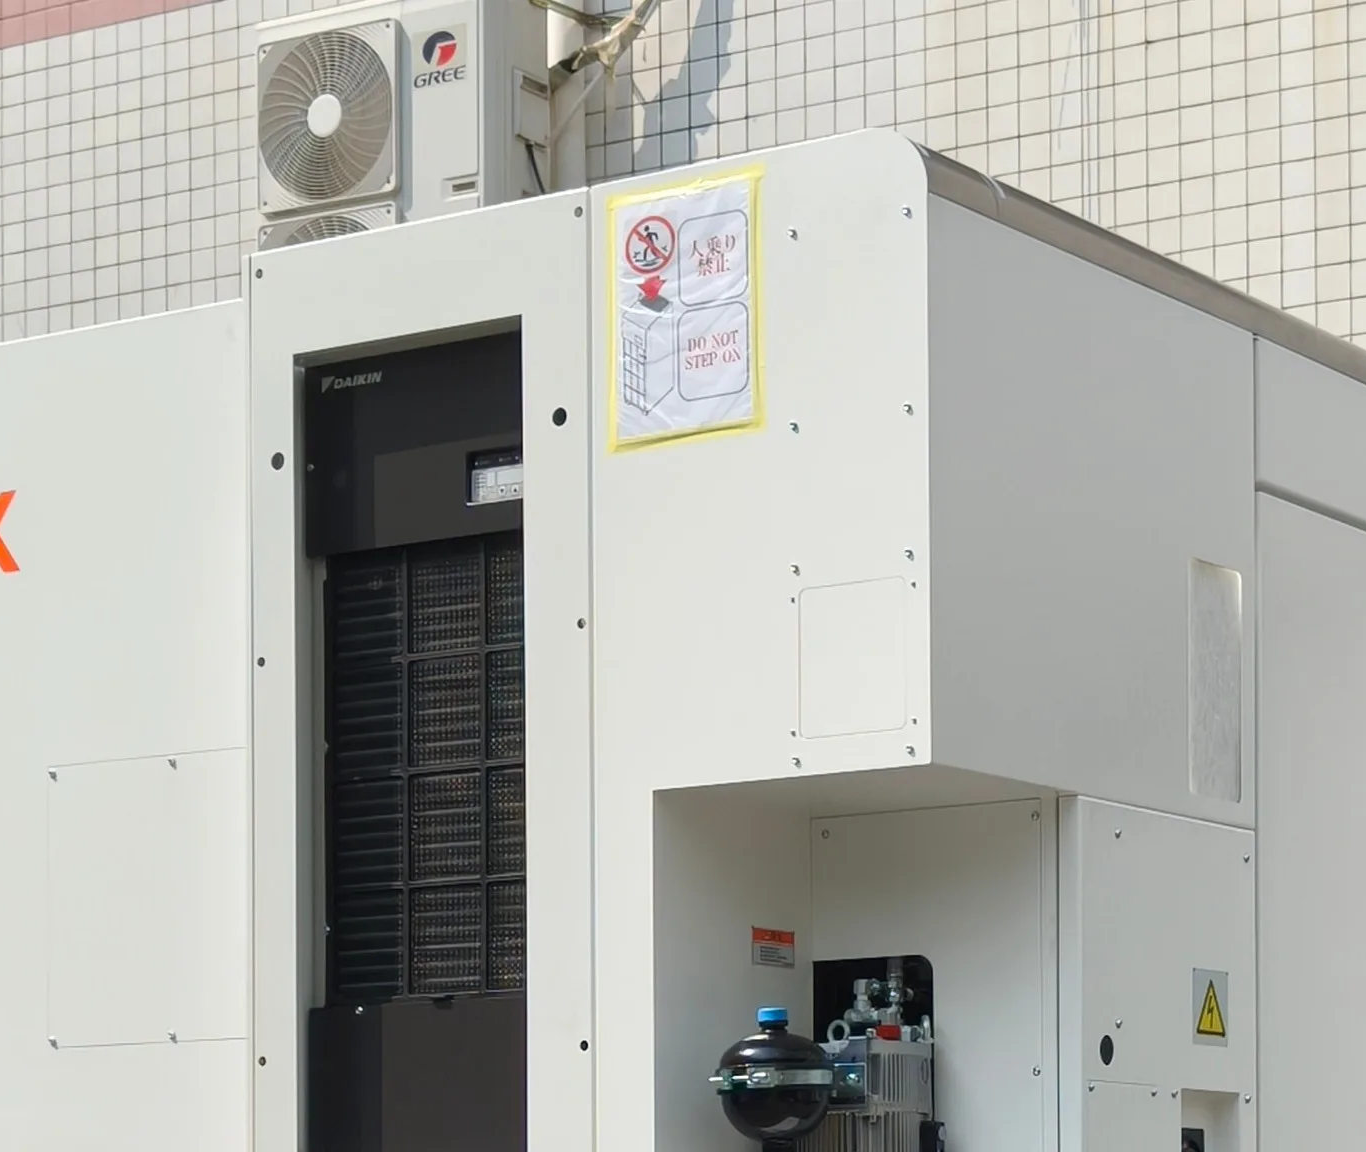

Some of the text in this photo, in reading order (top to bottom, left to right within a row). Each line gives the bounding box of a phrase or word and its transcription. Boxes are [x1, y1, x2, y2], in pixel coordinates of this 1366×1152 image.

[414, 65, 466, 88] GREE
[688, 330, 739, 352] DO NOT
[685, 348, 741, 370] STEP ON
[334, 371, 382, 389] DAIKIN
